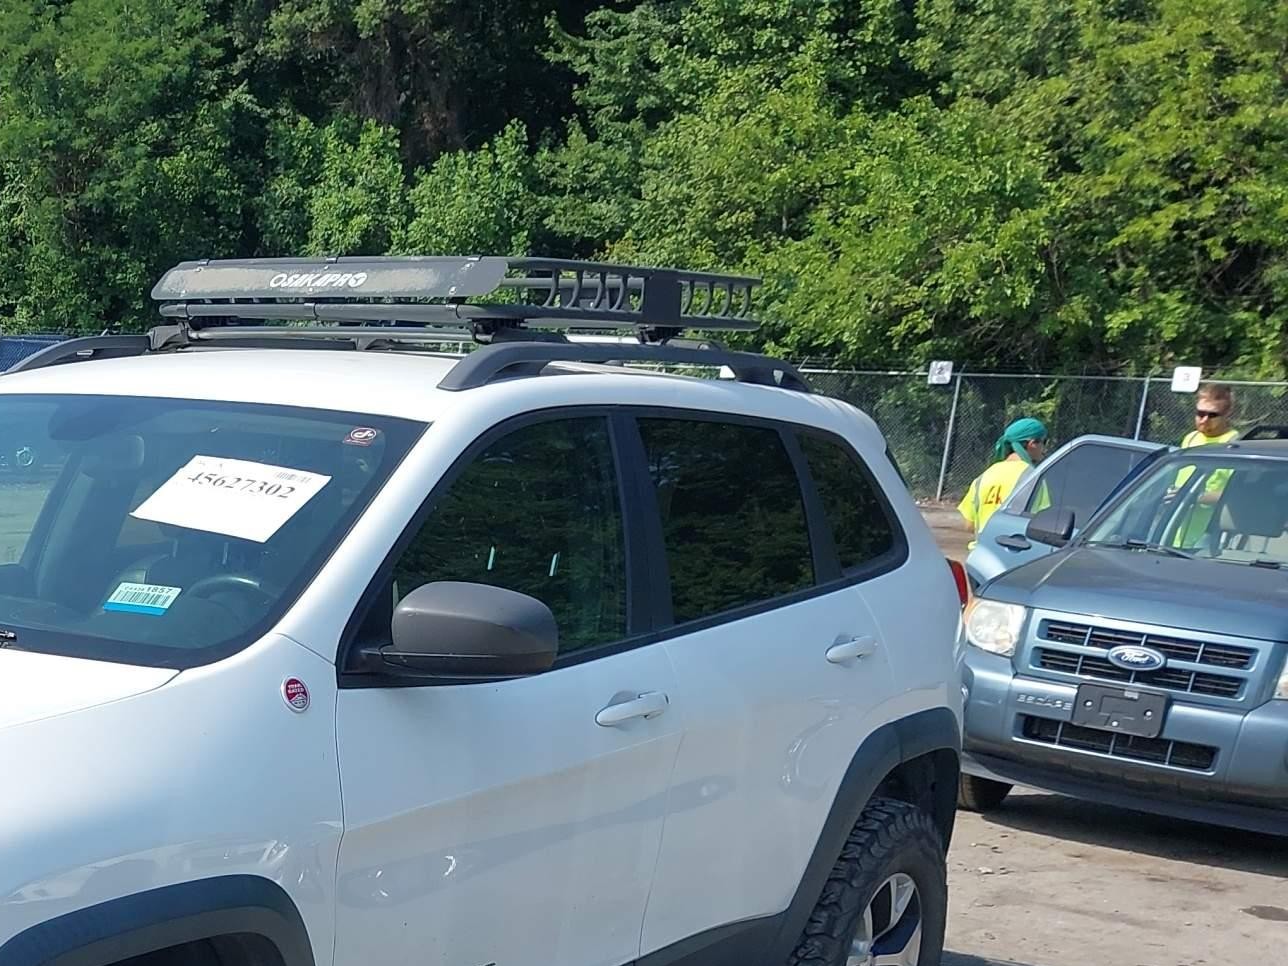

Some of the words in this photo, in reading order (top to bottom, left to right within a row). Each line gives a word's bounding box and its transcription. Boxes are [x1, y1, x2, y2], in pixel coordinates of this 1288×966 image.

[187, 470, 297, 499] 45627302
[146, 586, 174, 594] 1857
[1121, 650, 1150, 663] Ford
[1016, 694, 1073, 711] ESCAPE
